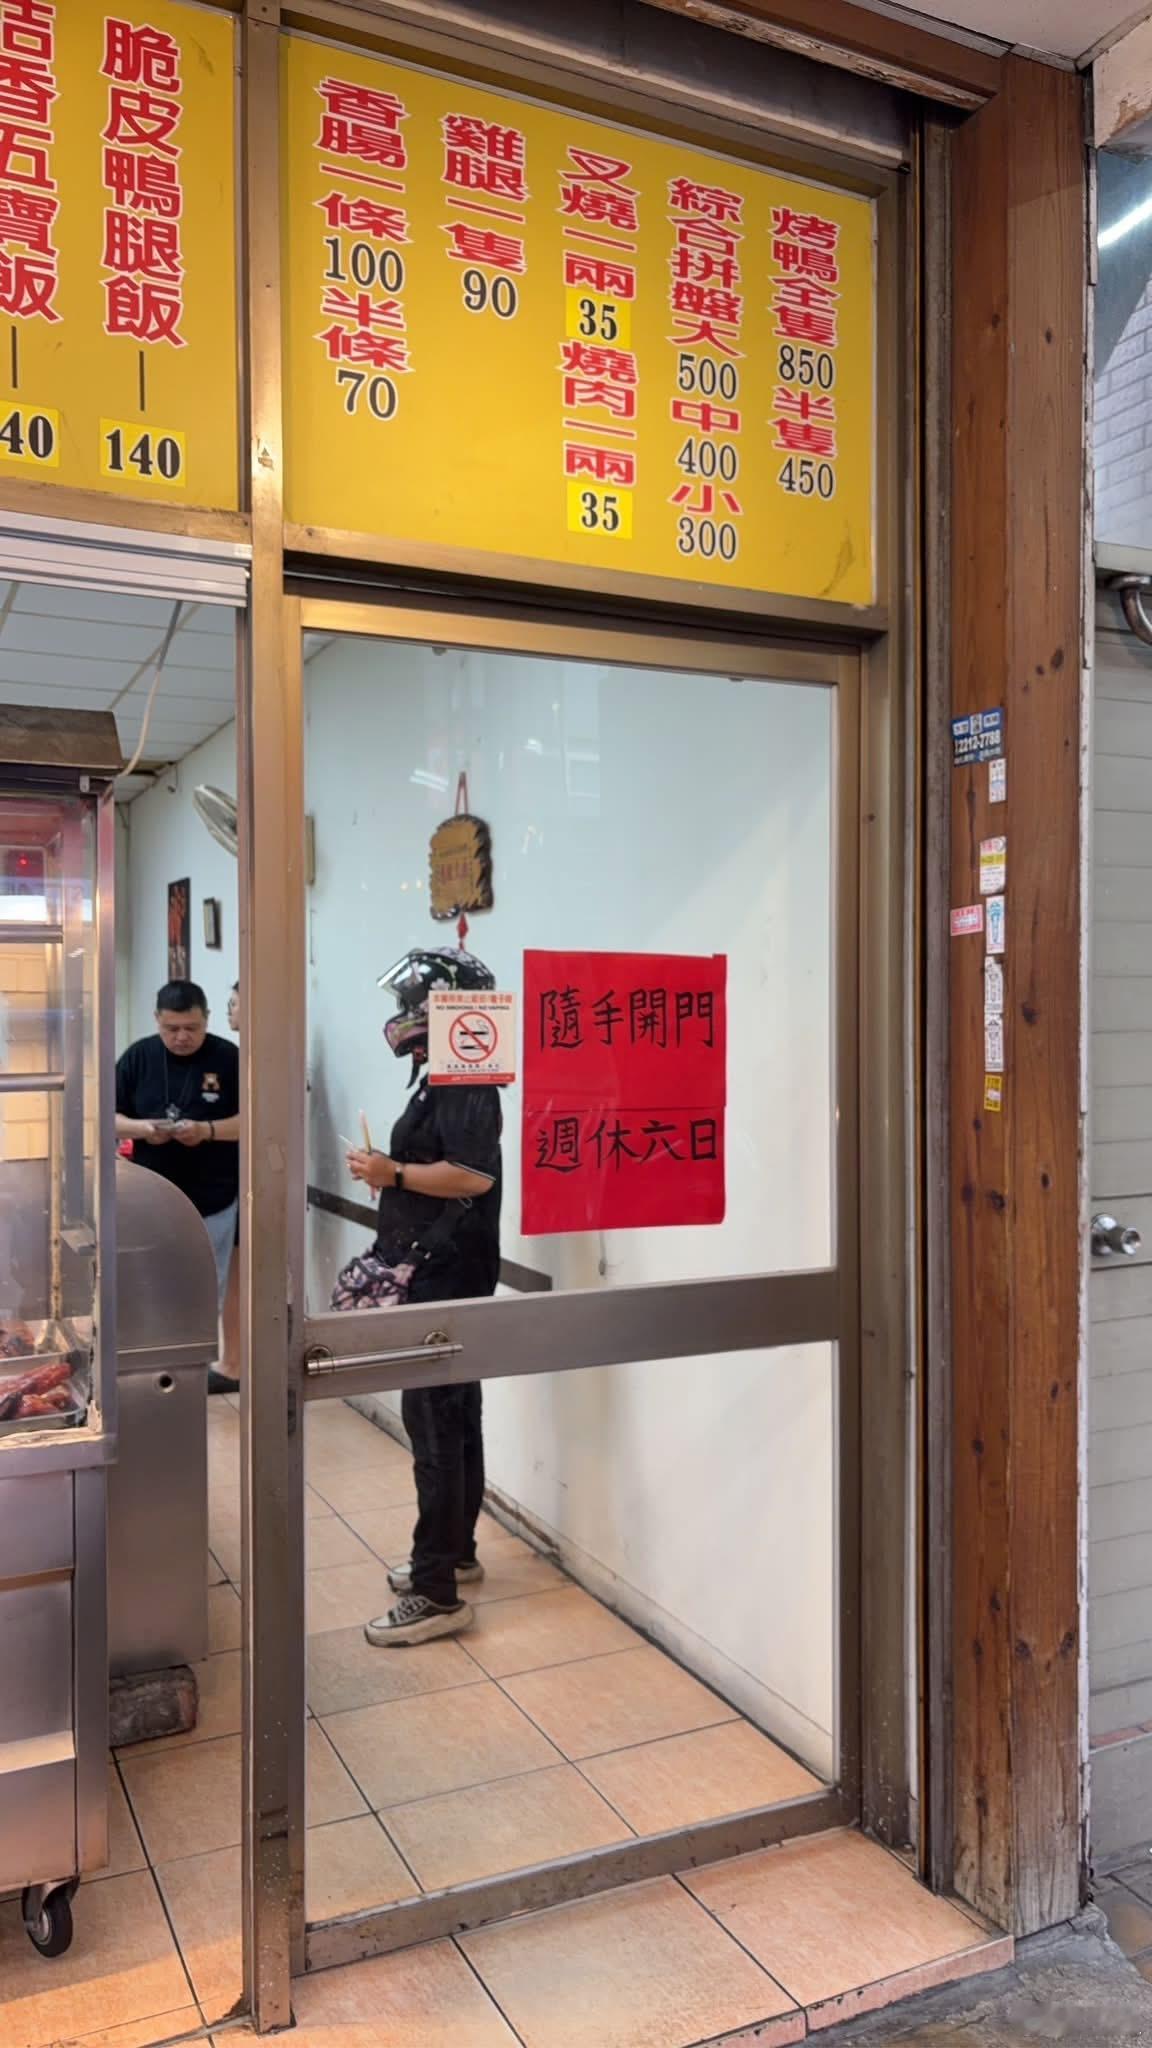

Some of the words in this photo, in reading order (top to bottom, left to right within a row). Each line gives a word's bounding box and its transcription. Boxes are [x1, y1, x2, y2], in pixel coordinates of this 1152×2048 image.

[101, 17, 186, 346] 脆皮鴨腿飯
[315, 77, 411, 243] 香腸一條
[440, 112, 528, 274] 雞腿一隻
[559, 146, 640, 299] 叉燒一兩
[325, 238, 403, 293] 100
[769, 207, 840, 348] 烤鴨全隻
[463, 269, 517, 318] 90
[579, 298, 617, 340] 35
[315, 288, 412, 372] 半條
[678, 354, 737, 400] 500
[779, 346, 834, 389] 850
[337, 370, 397, 419] 70
[559, 340, 638, 485] 燒肉一兩
[671, 399, 741, 433] 中
[769, 386, 835, 458] 半隻
[105, 428, 181, 479] 140
[678, 438, 737, 481] 400
[779, 458, 834, 499] 450
[581, 492, 619, 532] 35
[669, 484, 743, 514] 小
[678, 517, 737, 560] 300
[539, 984, 716, 1052] 隨手開門
[535, 1117, 716, 1173] 週休六日
